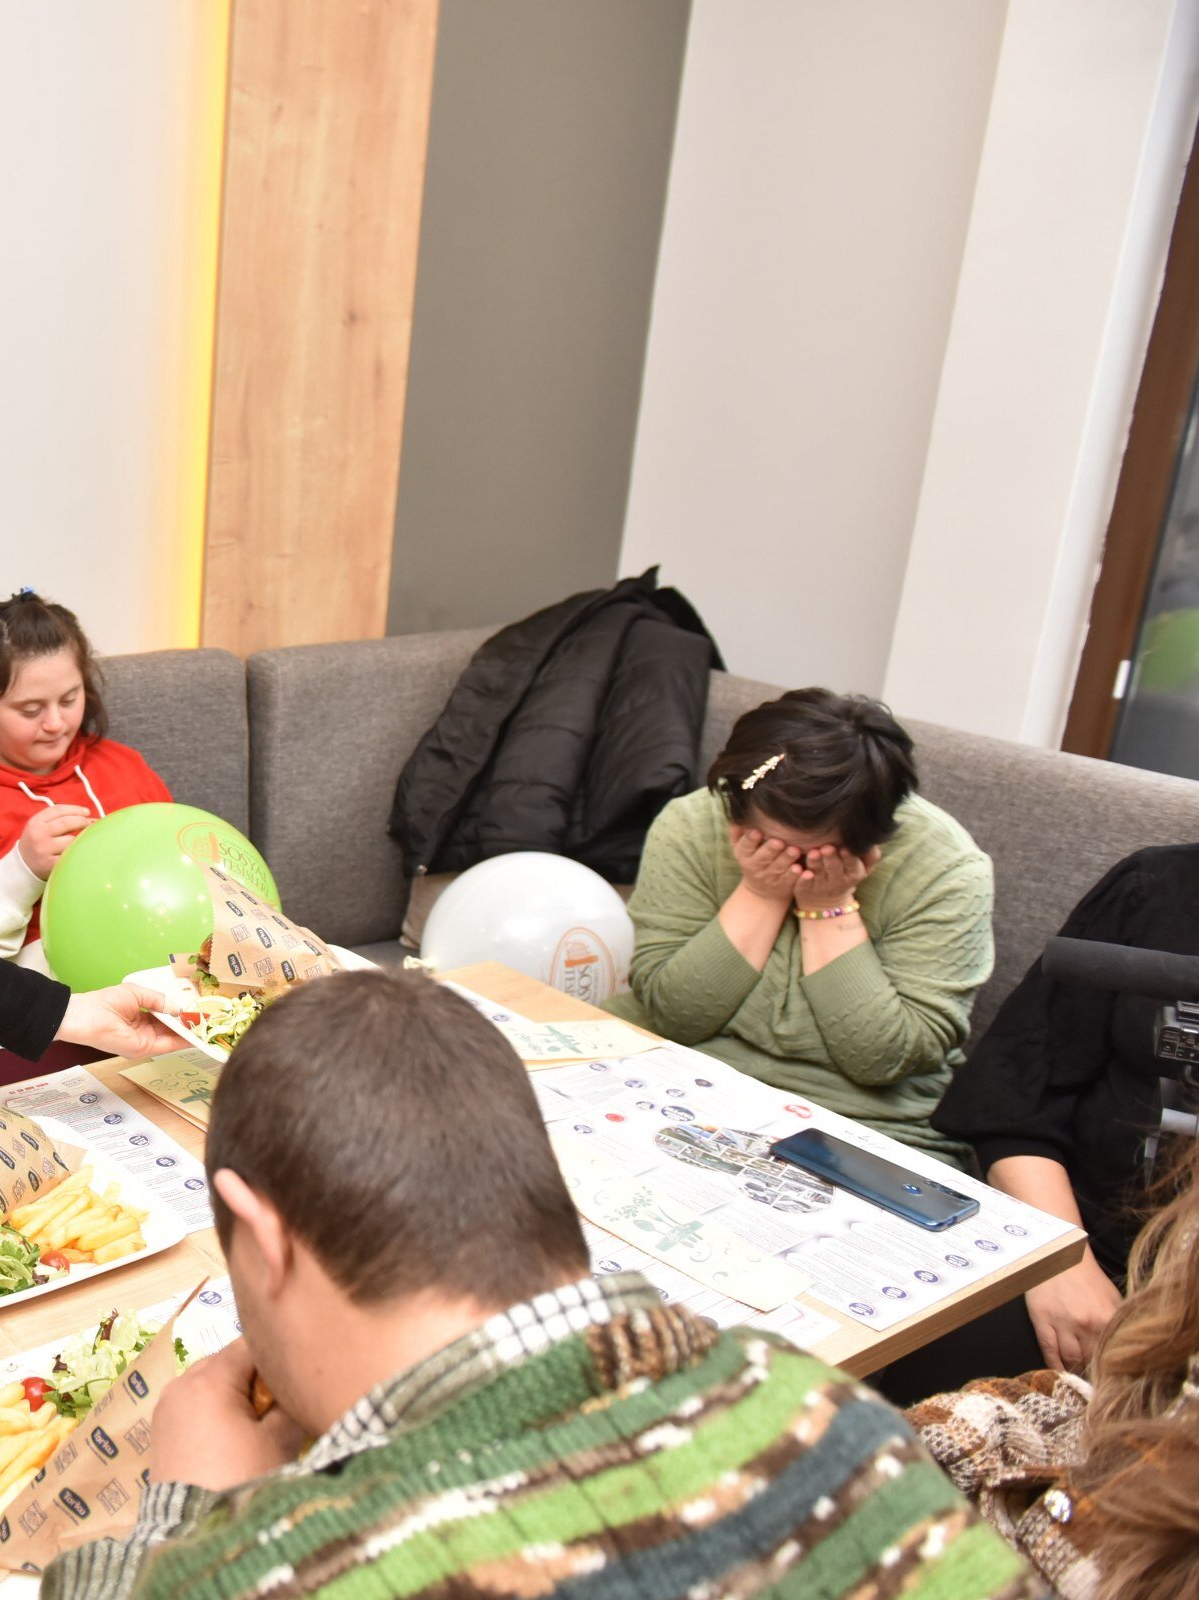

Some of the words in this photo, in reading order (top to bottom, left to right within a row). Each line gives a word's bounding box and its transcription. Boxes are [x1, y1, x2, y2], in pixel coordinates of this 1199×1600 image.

[129, 1371, 146, 1397] Torku
[93, 1428, 115, 1456] Torku
[63, 1490, 87, 1516] Torku
